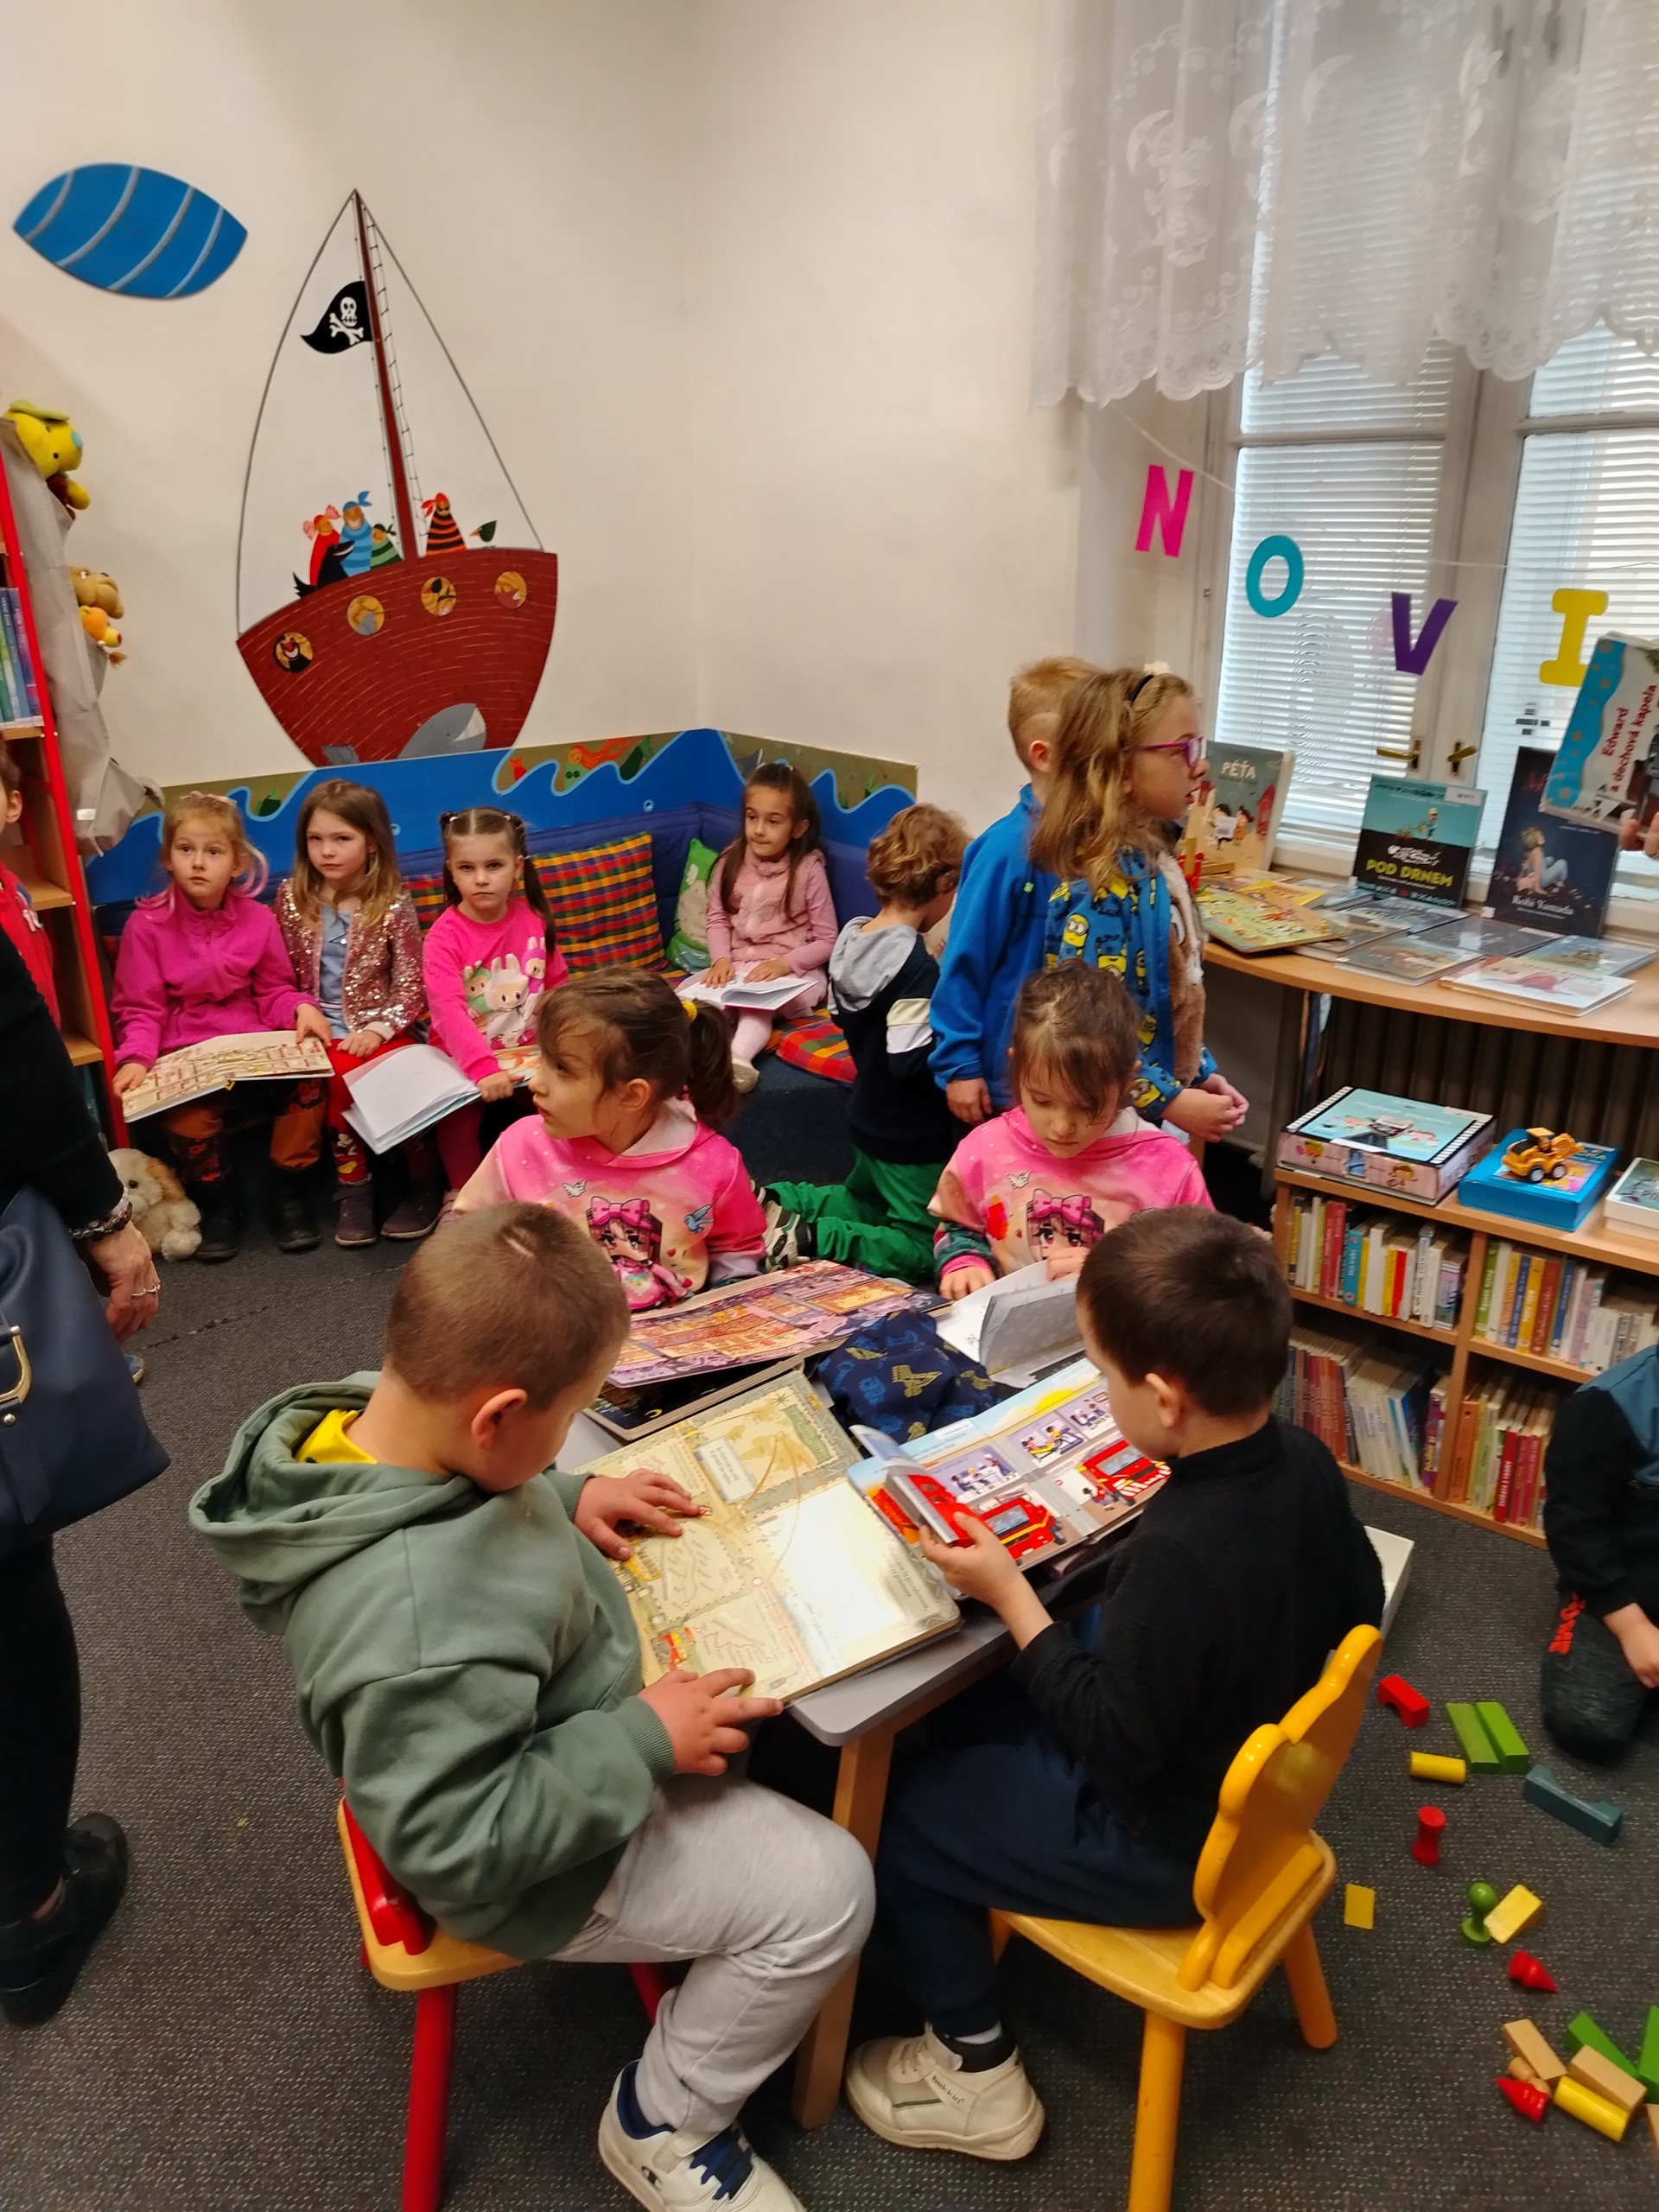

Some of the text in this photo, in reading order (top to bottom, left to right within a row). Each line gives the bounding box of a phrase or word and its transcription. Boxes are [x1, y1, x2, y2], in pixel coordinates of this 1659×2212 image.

[1601, 708, 1629, 756] Edward
[1610, 785, 1620, 793] a
[1630, 684, 1658, 727] kapela
[1365, 858, 1398, 875] POD
